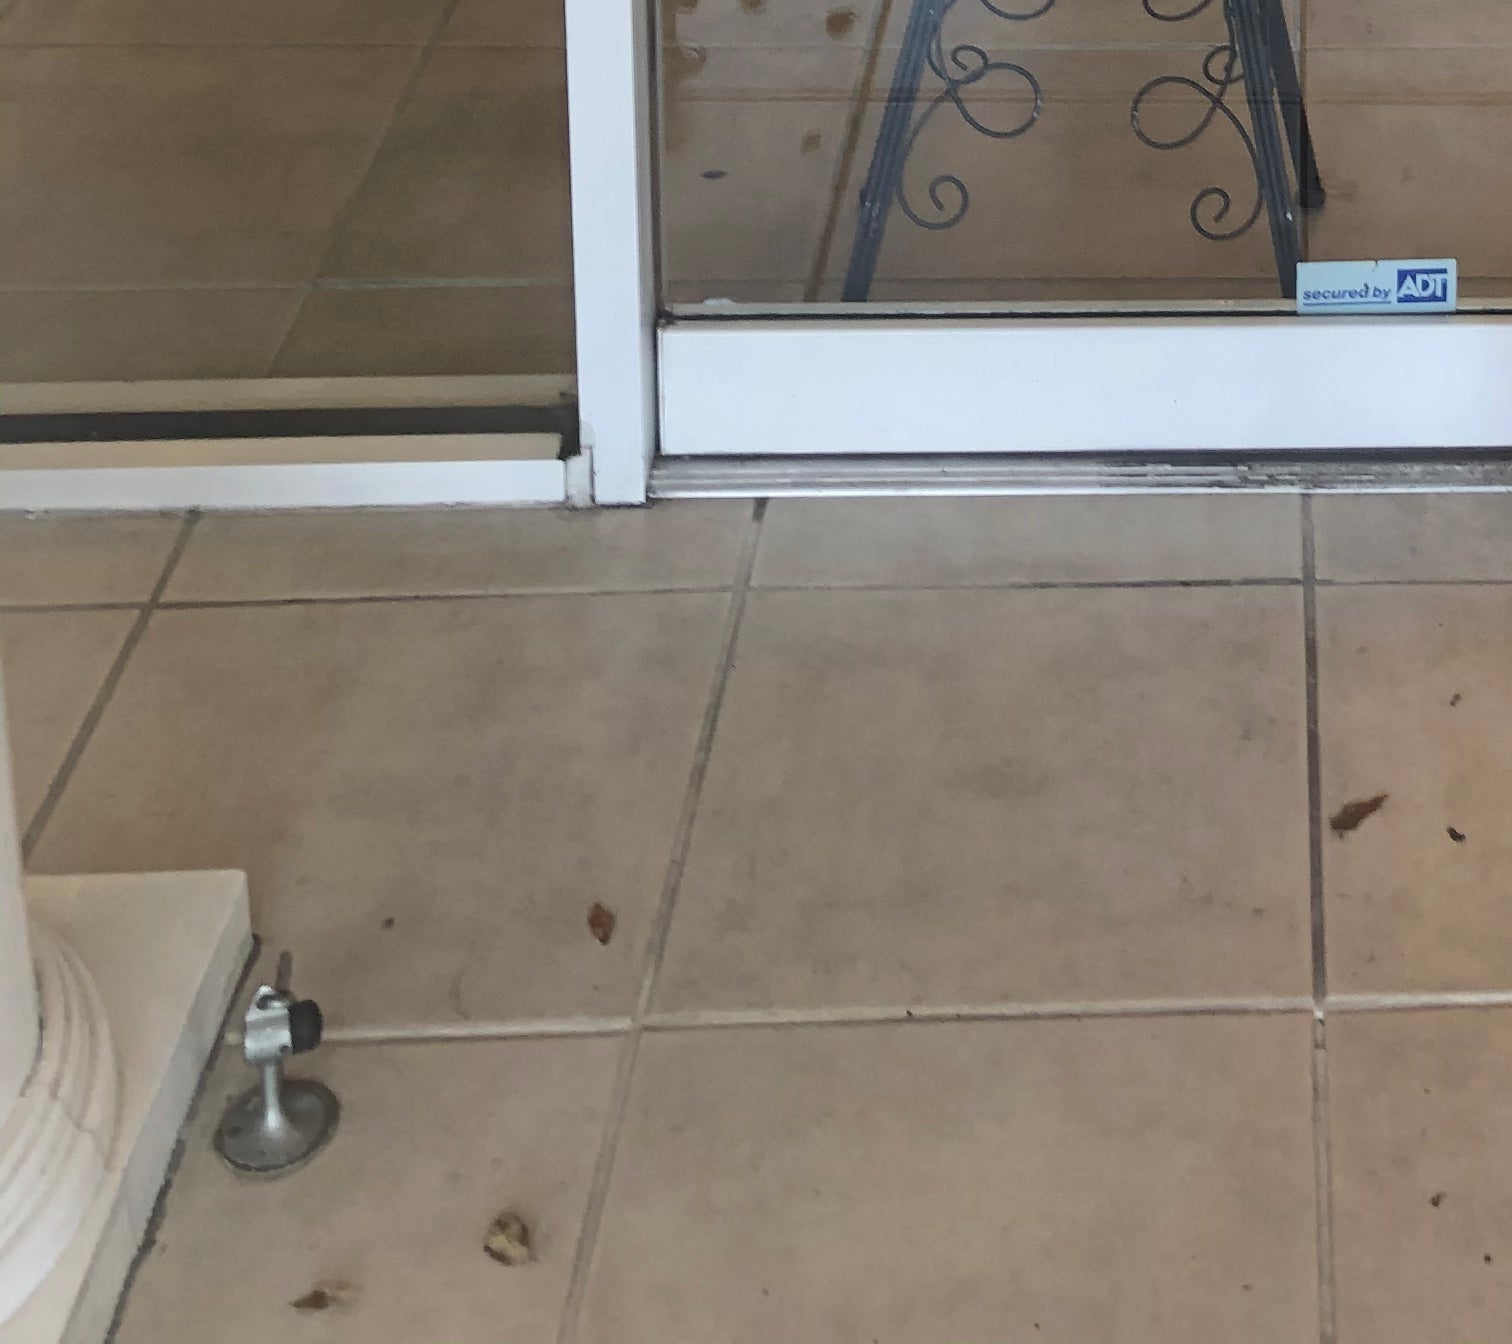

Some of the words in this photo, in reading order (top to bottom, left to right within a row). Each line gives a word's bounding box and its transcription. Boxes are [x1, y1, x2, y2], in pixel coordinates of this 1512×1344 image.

[1302, 283, 1369, 301] secured
[1372, 285, 1392, 300] by
[1398, 271, 1448, 299] ADT
